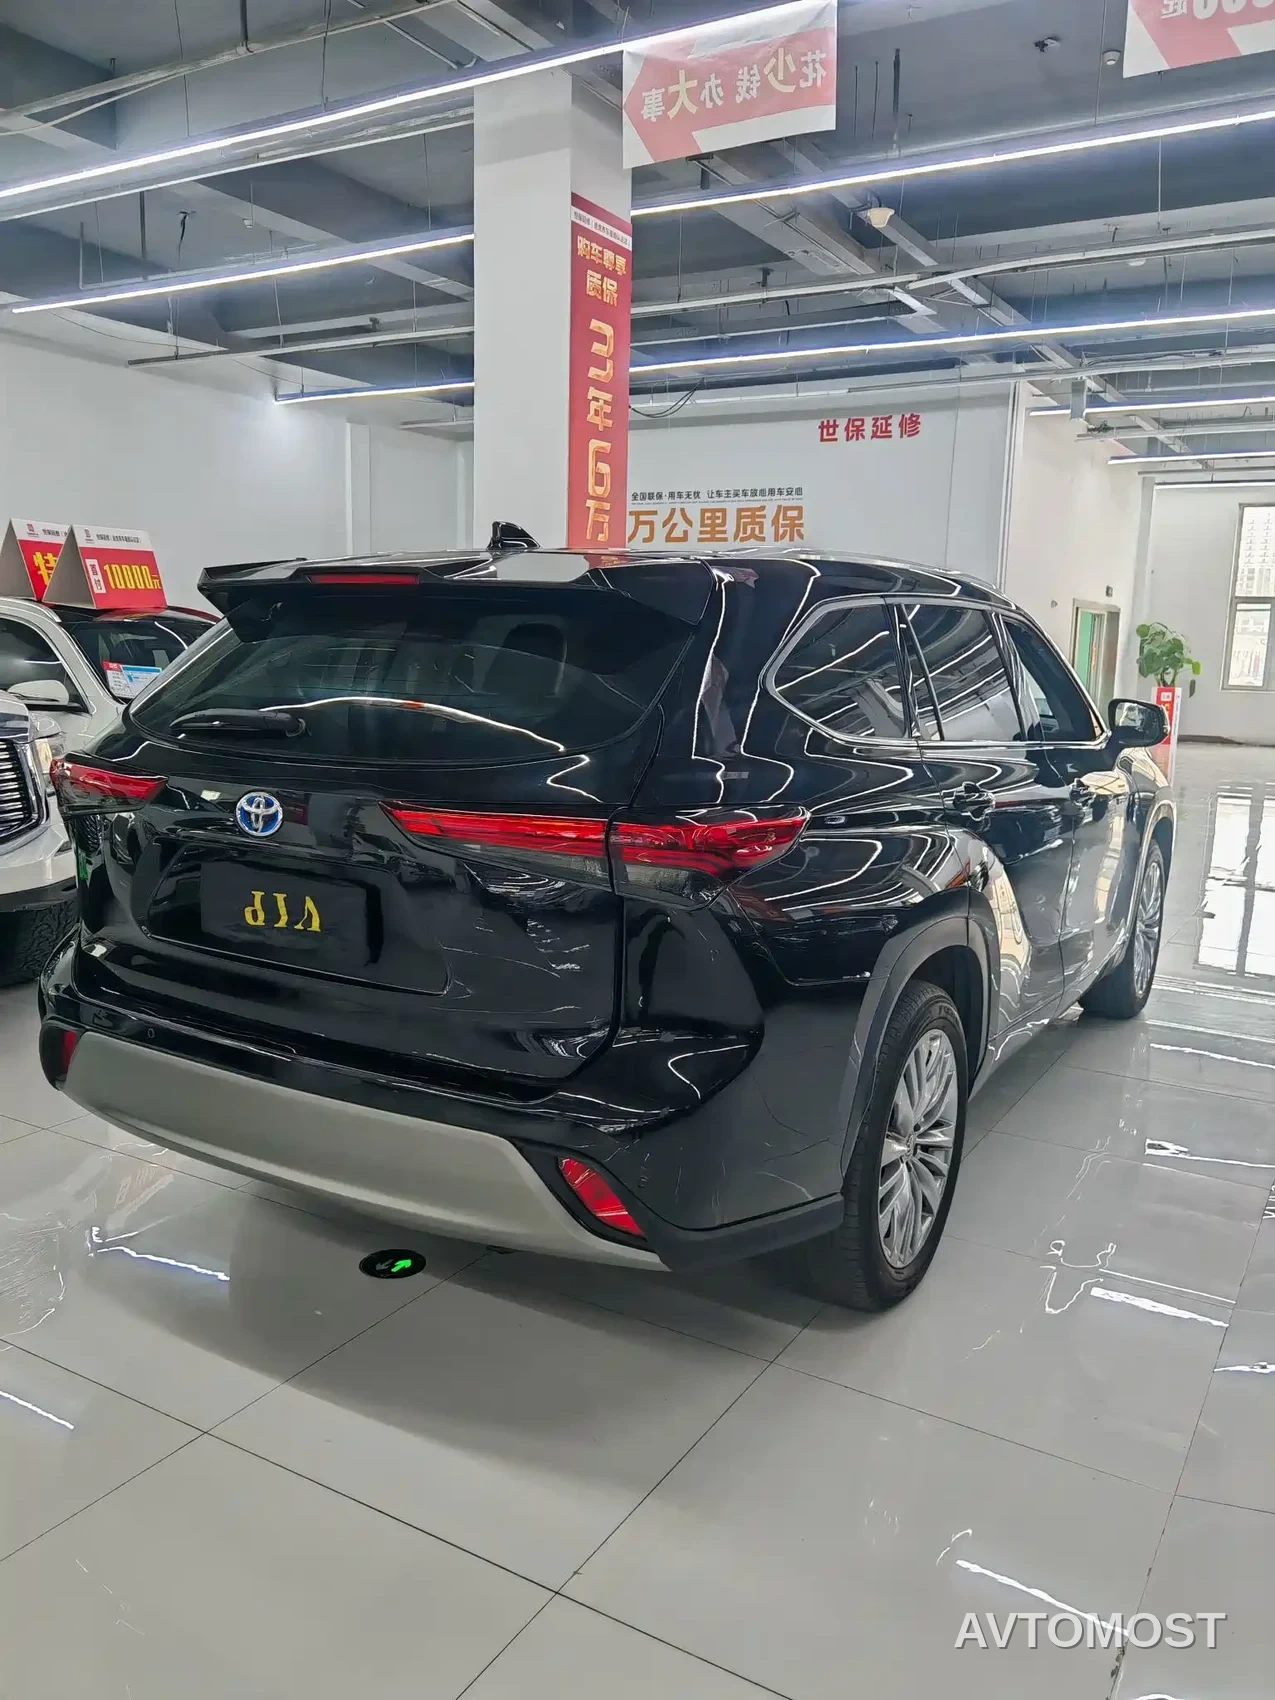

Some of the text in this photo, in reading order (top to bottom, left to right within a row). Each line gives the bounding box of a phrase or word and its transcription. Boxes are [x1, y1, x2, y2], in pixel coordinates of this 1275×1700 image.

[586, 269, 618, 307] 质保
[818, 413, 921, 442] 世保延修
[627, 504, 804, 543] 万公里质保
[244, 891, 321, 932] VIP
